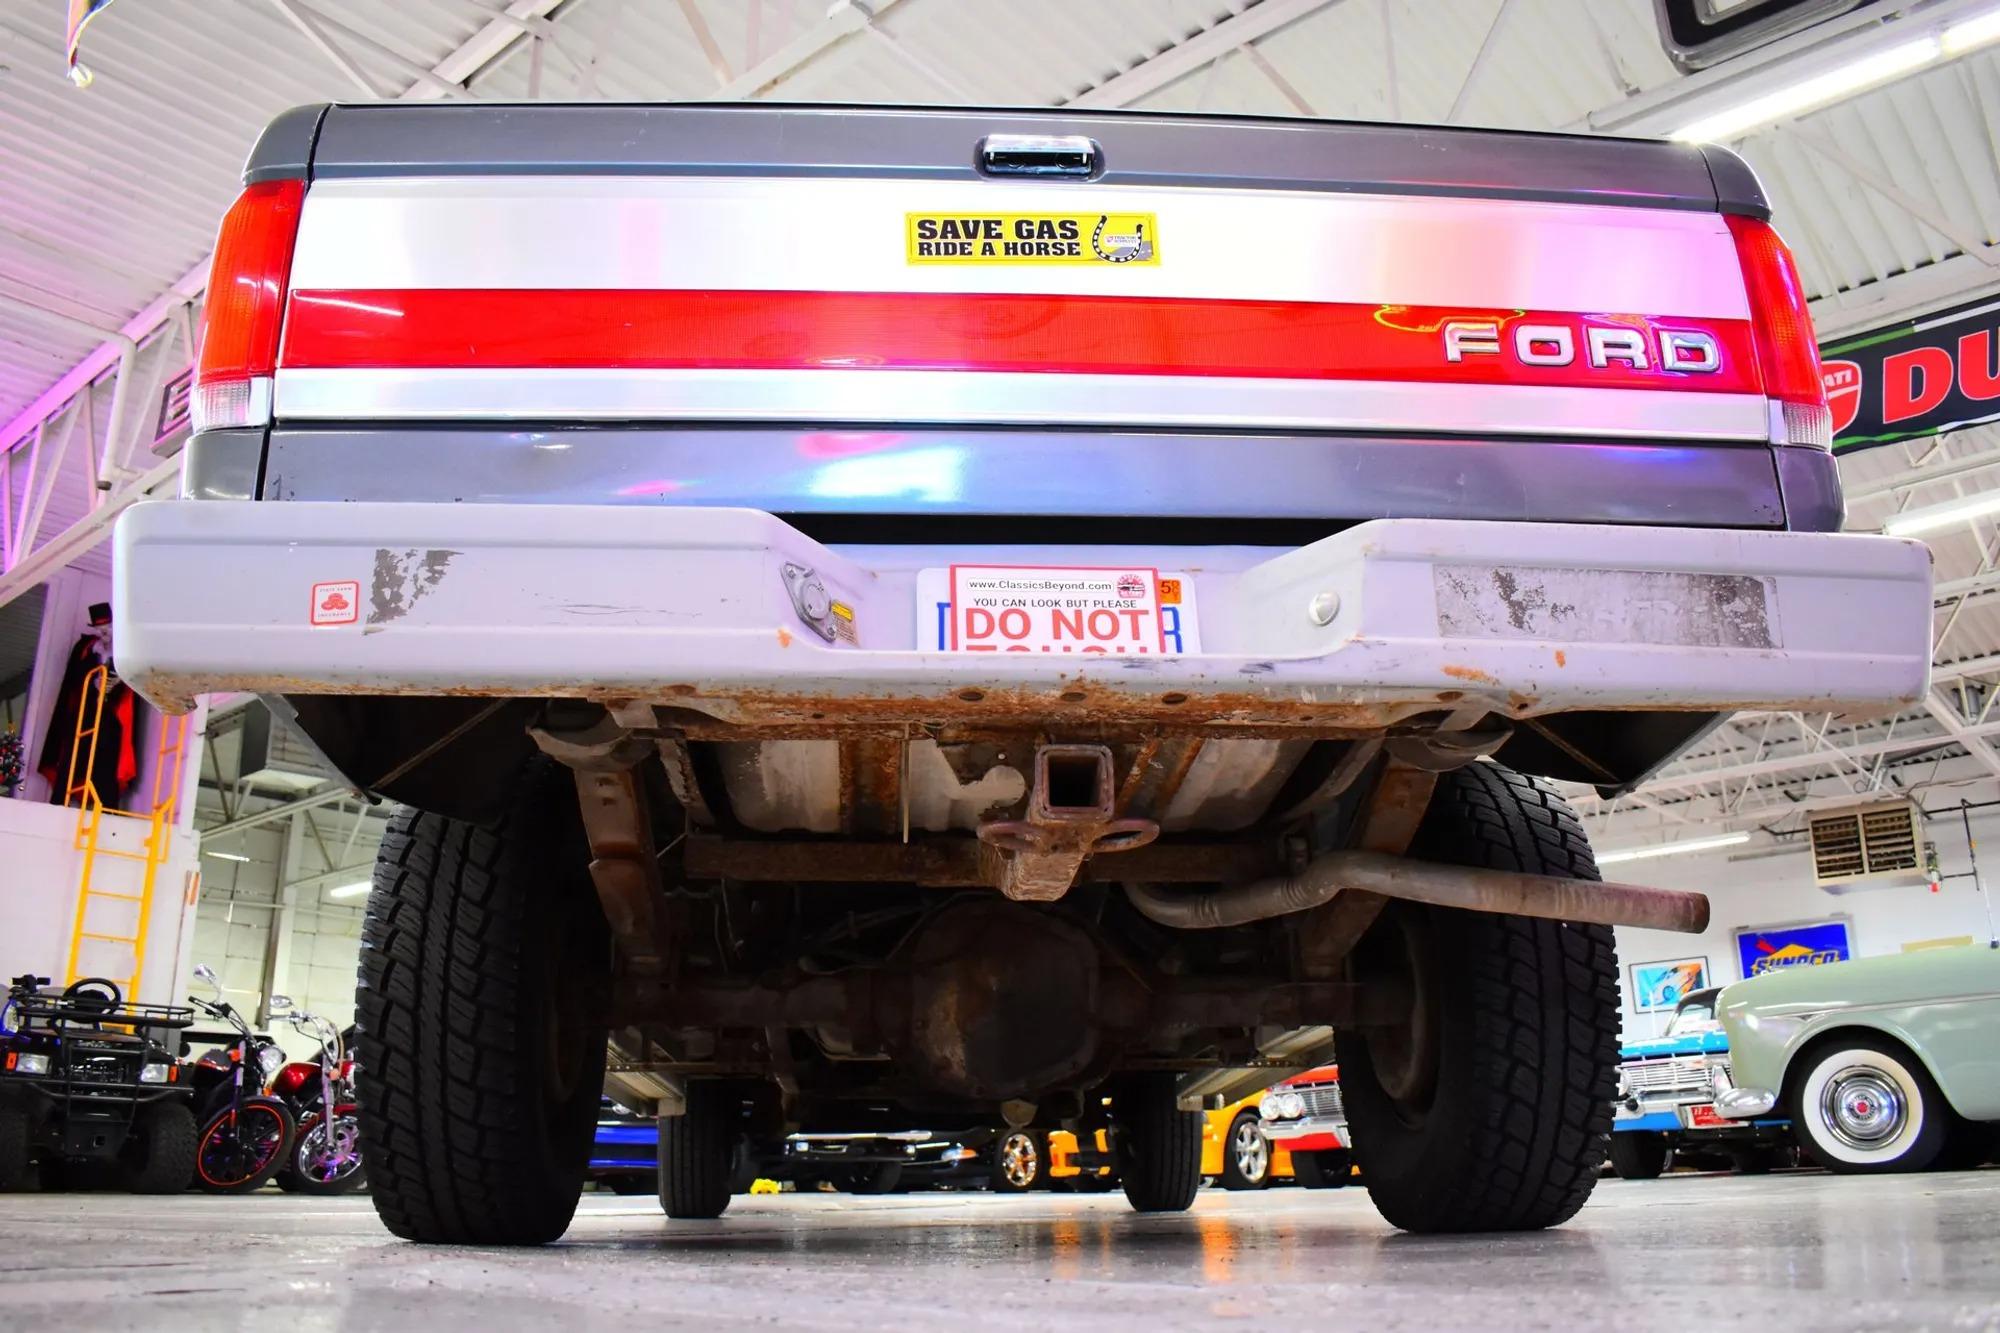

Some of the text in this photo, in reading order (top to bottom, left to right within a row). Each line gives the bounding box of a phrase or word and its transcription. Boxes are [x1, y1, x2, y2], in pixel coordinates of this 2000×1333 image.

[917, 219, 1079, 240] SAVE GAS
[918, 241, 1081, 256] RIDE A HORSE
[1443, 321, 1721, 372] FORD
[969, 580, 1112, 592] www.ClassicsBeyond.com
[974, 598, 1137, 608] YOU CAN LOOK BUT PLEASE
[965, 608, 1031, 640] DO
[1051, 608, 1149, 641] NOT
